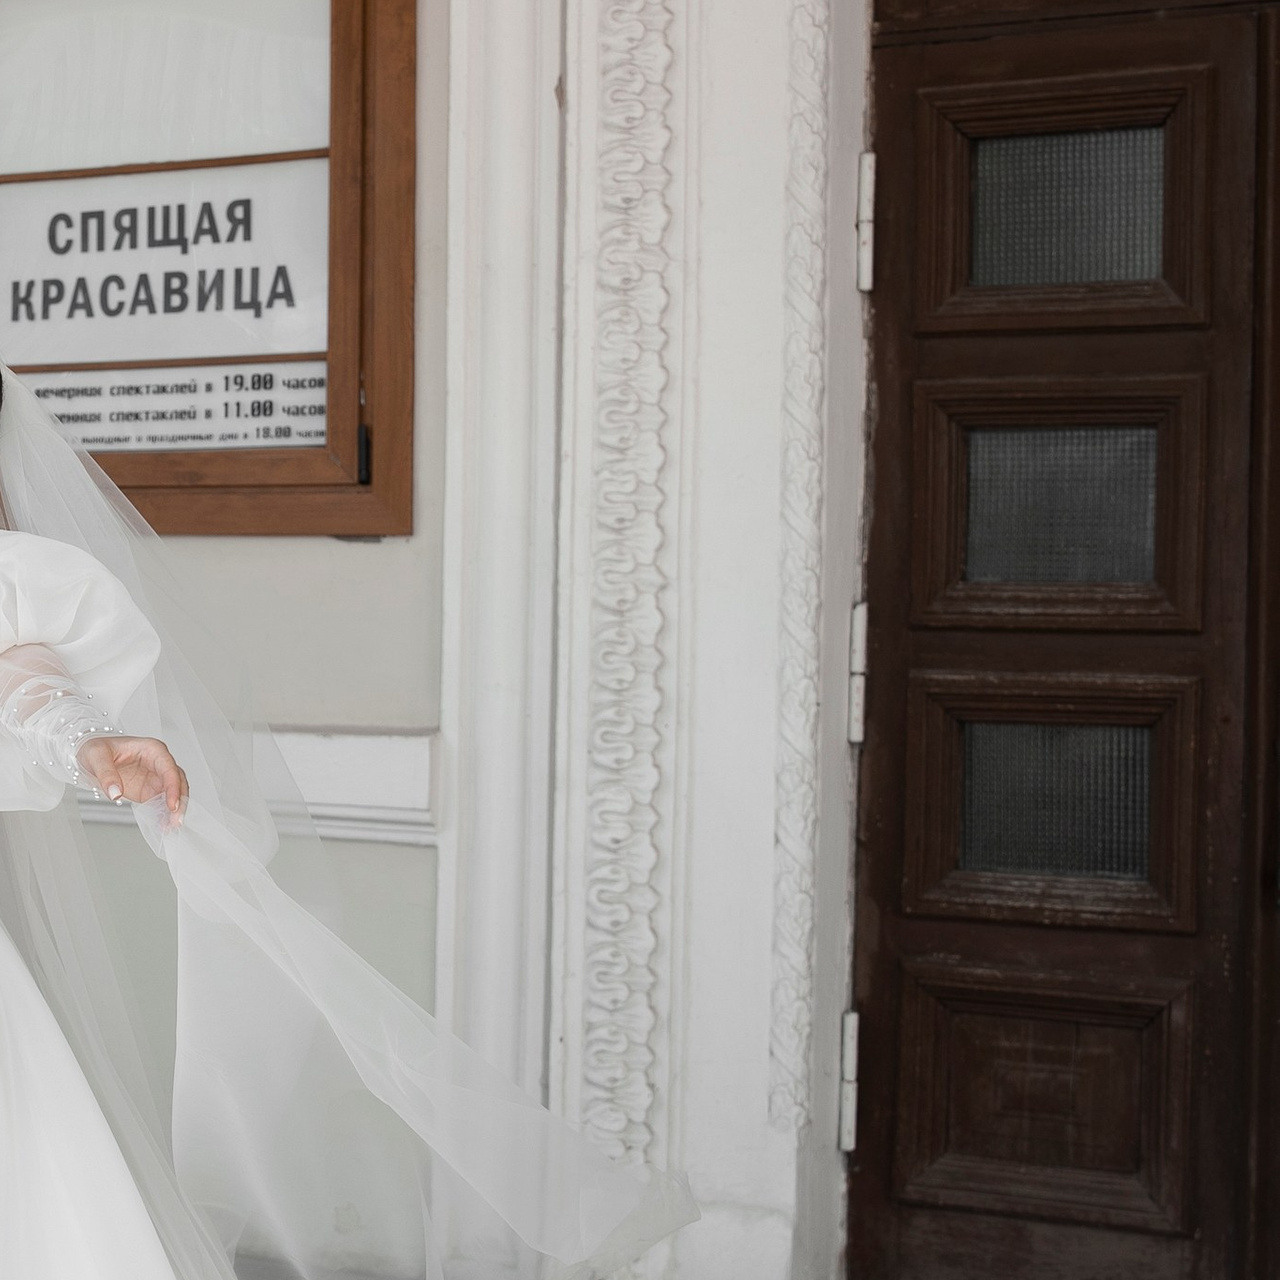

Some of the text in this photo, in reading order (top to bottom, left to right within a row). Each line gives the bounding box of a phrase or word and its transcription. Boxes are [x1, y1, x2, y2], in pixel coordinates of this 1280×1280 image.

[47, 198, 253, 255] СПЯЩАЯ
[10, 265, 296, 322] КРАСАВИЦА
[109, 379, 197, 397] спектаклей
[224, 372, 274, 392] 19.00
[282, 377, 326, 390] часов
[109, 405, 197, 422] спектаклей
[224, 400, 273, 419] 11.00
[282, 404, 326, 417] часов
